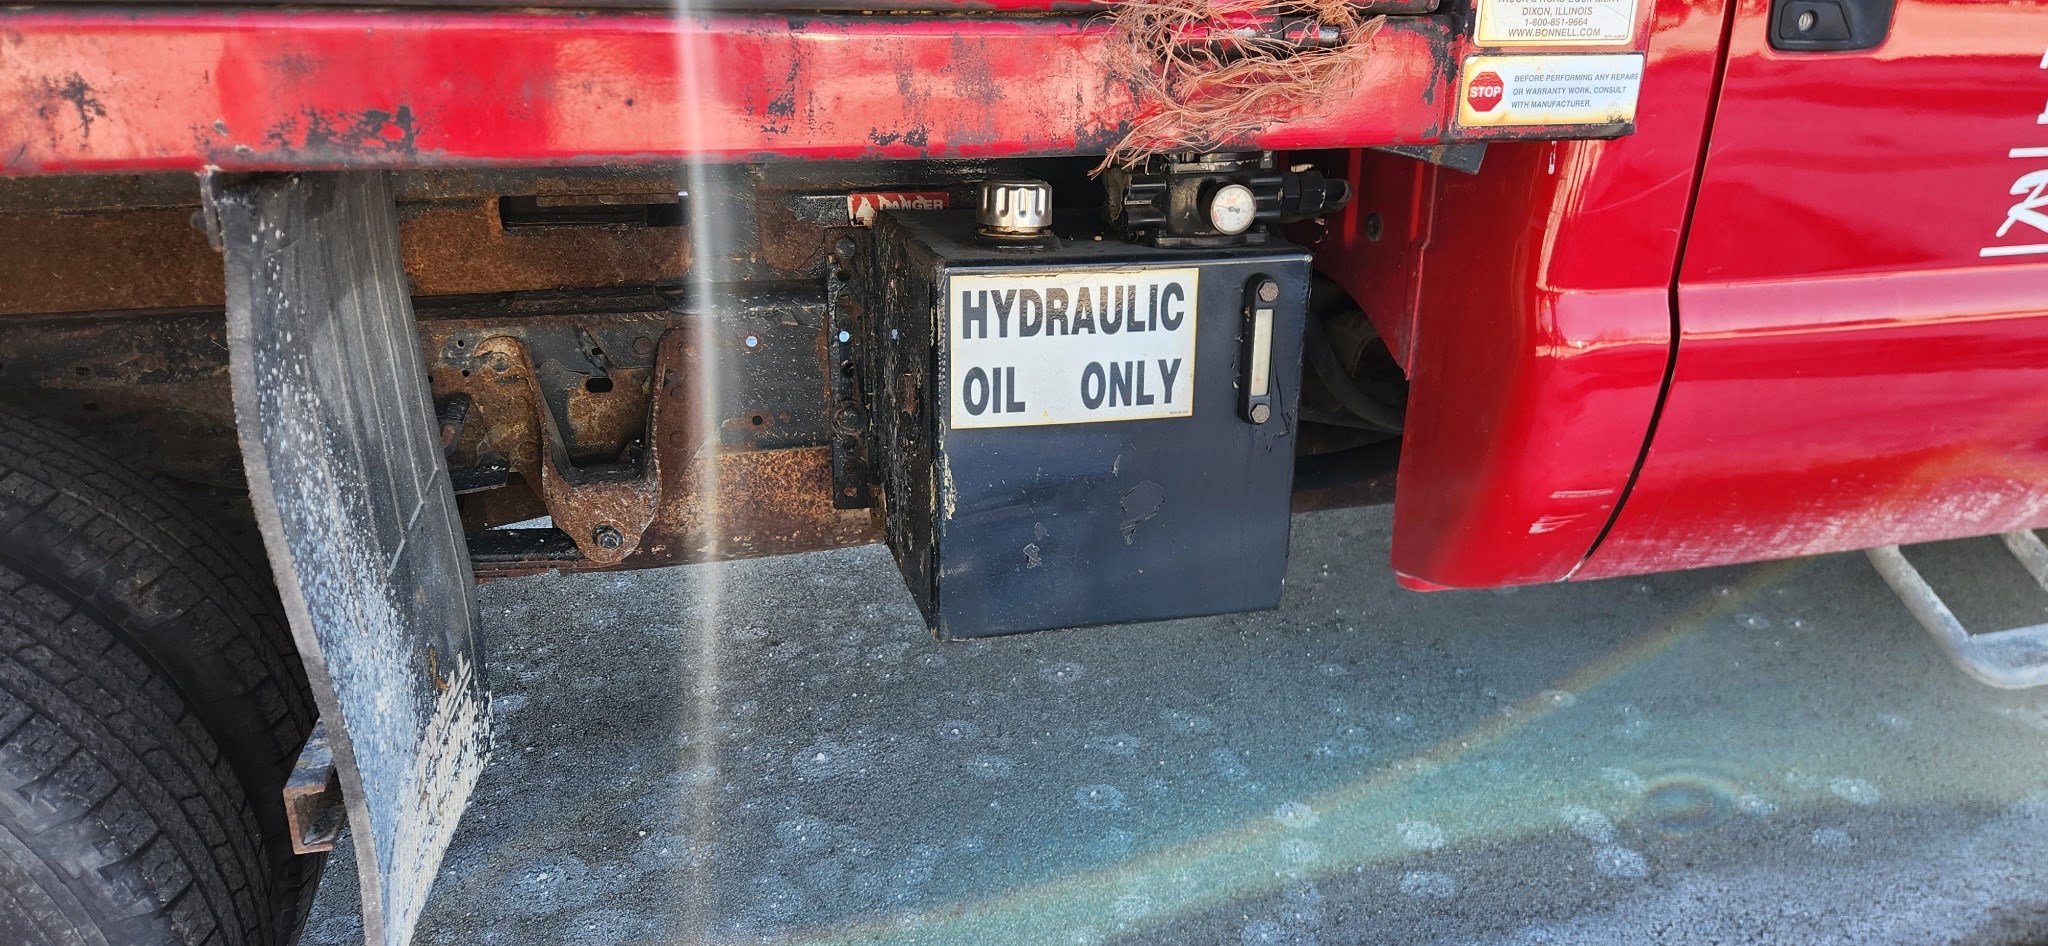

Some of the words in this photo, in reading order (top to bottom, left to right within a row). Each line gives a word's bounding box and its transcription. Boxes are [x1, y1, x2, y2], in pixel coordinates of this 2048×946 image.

[1522, 7, 1552, 16] DIXON,
[1555, 7, 1593, 15] ILLINOIS
[1525, 18, 1588, 26] 1-800-851-9664
[1508, 28, 1601, 37] WWW.BONNELL.COM
[1546, 74, 1593, 82] PERFORMING
[1594, 73, 1609, 81] ANY
[1611, 73, 1639, 81] REPAIRS
[1469, 86, 1503, 98] STOP
[1525, 87, 1566, 95] WARRANTY
[1568, 86, 1591, 95] WORK,
[1593, 86, 1627, 94] CONSULT
[1511, 101, 1529, 109] WITH
[1530, 100, 1592, 109] MANUFACTURER.
[962, 282, 1185, 340] HYDRAULIC
[962, 366, 1026, 416] OIL
[1080, 358, 1182, 410] ONLY
